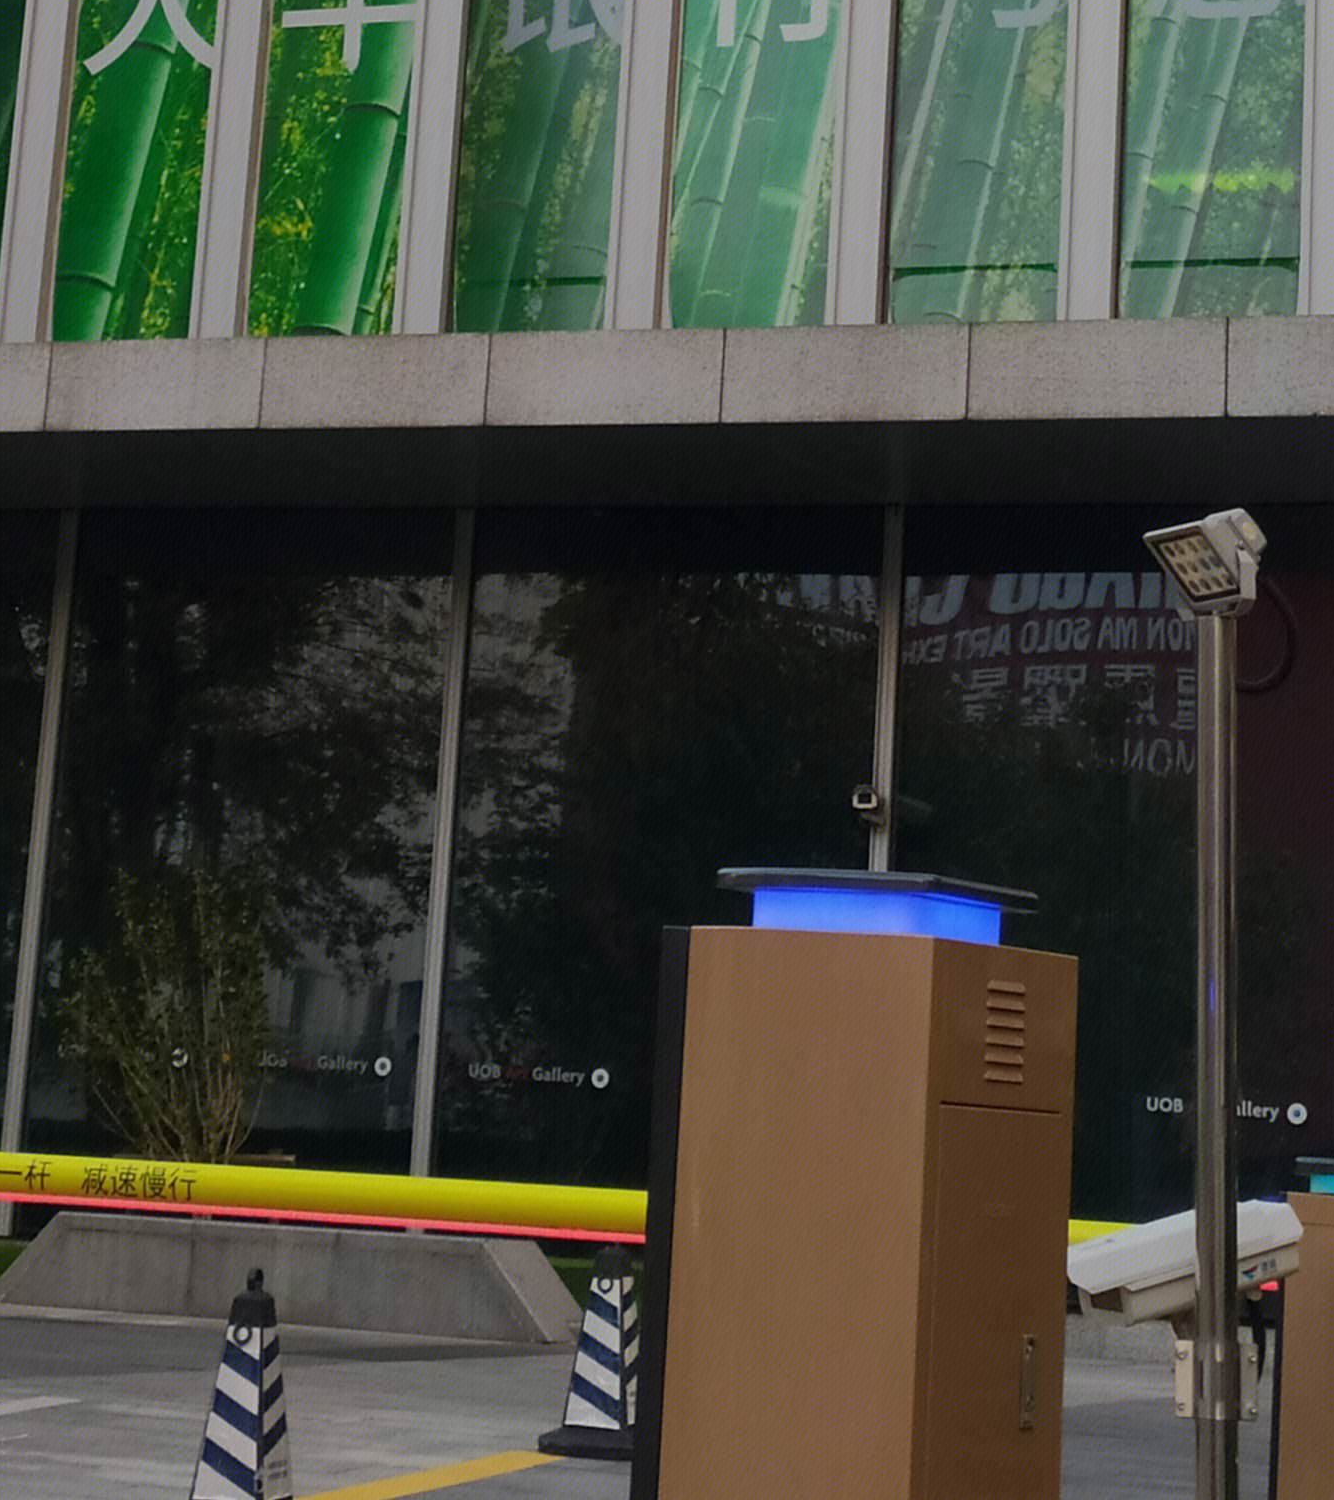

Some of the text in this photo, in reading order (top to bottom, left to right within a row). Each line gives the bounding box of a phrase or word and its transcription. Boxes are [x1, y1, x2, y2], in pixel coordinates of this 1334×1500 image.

[317, 1055, 368, 1075] Gallery
[467, 1062, 502, 1079] UOB
[531, 1066, 586, 1087] Gallery
[1145, 1096, 1280, 1123] UOB llery
[80, 1162, 198, 1202] 减速慢行
